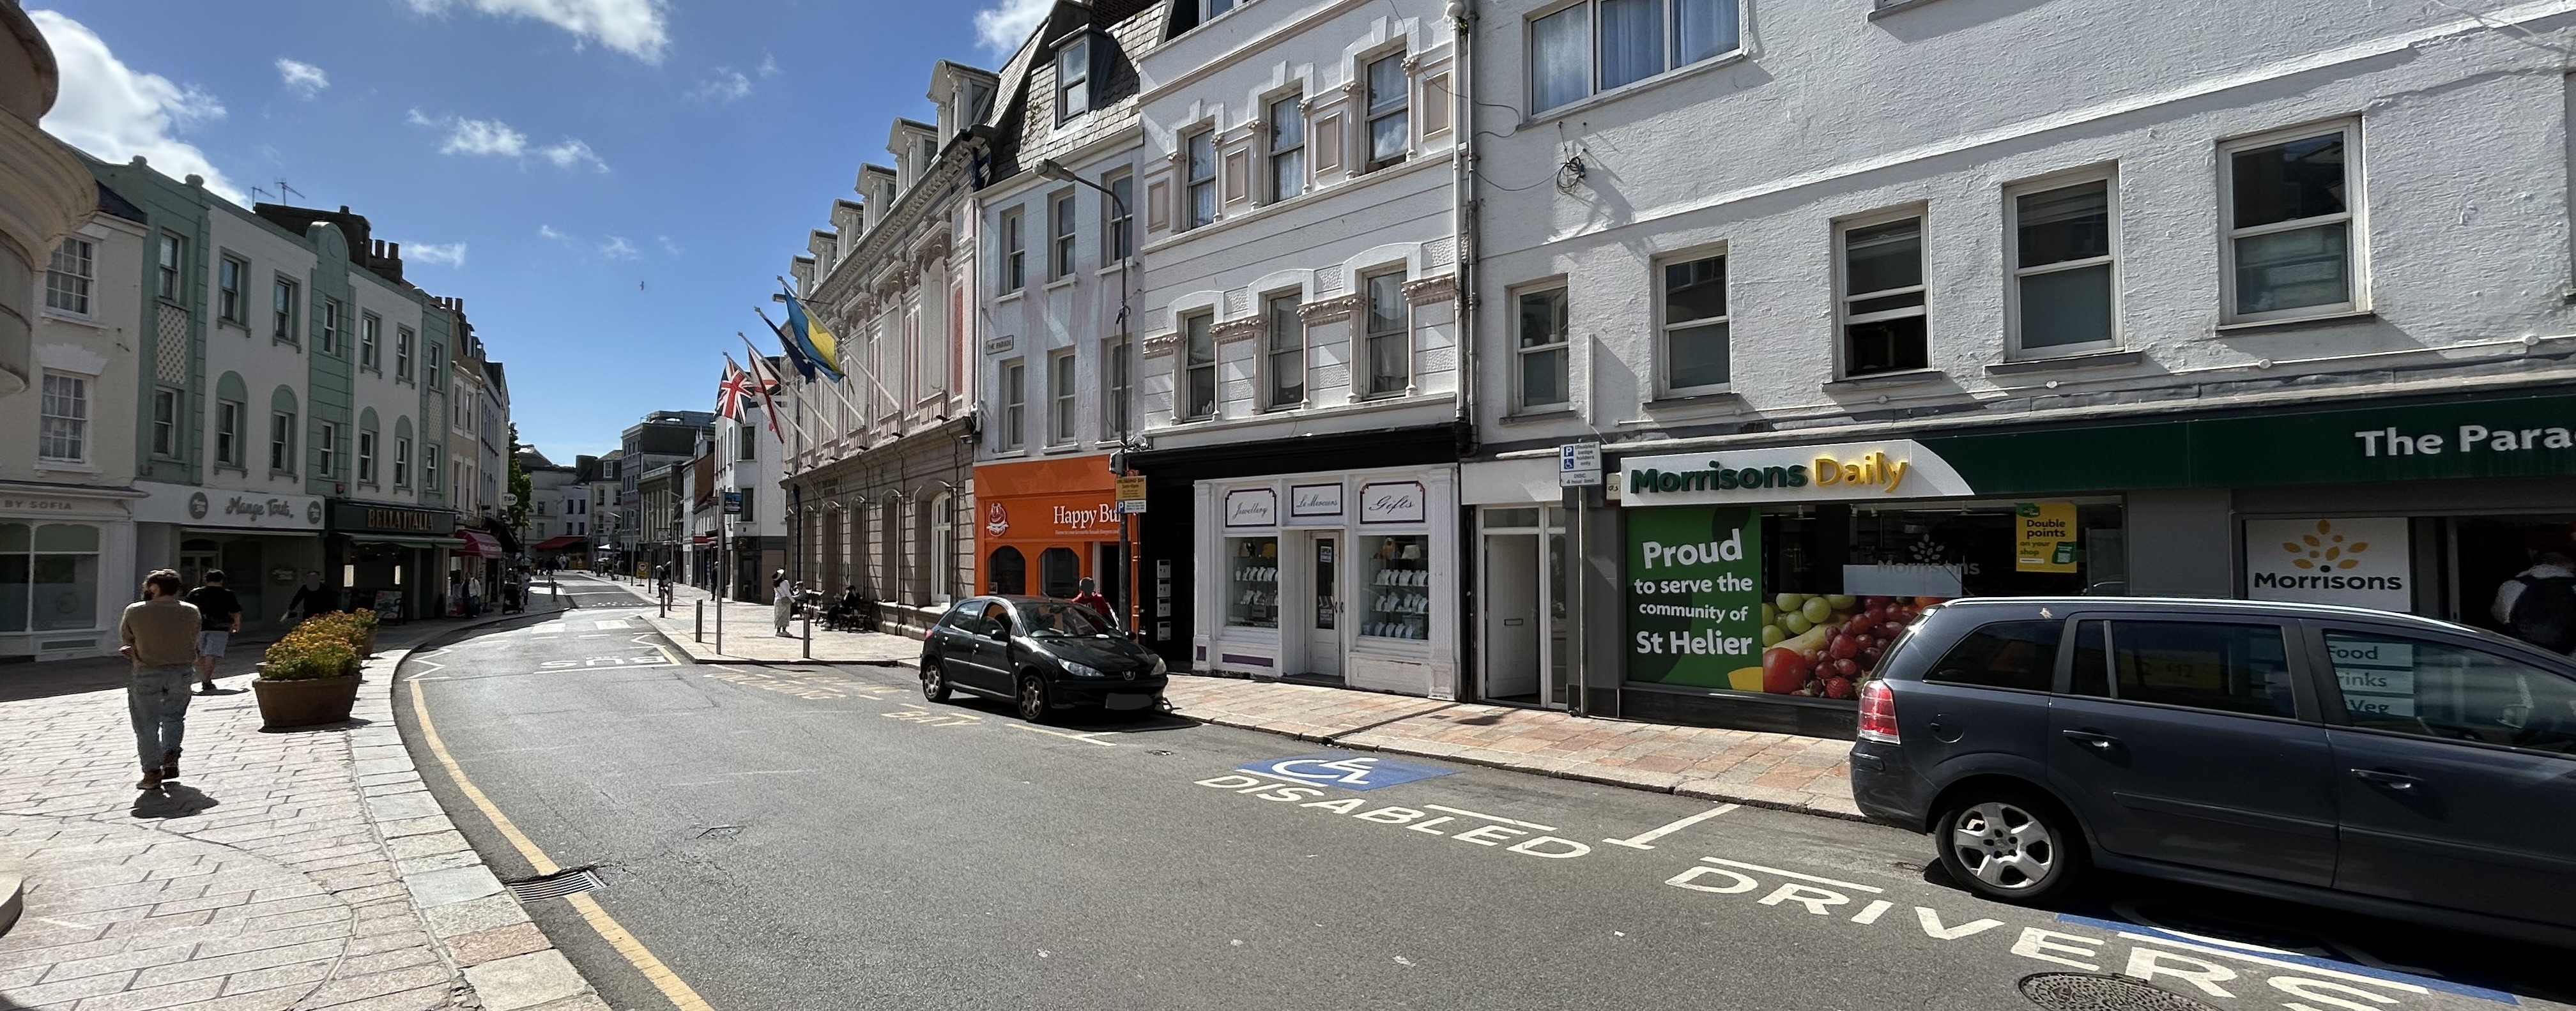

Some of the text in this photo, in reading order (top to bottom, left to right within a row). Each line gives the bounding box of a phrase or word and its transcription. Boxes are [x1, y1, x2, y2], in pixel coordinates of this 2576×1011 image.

[1566, 447, 1572, 457] P
[2355, 425, 2576, 457] The Para
[1630, 452, 1908, 494] Morrisons Daily
[29, 501, 72, 510] SOFIA
[225, 496, 265, 522] Mange
[1054, 503, 1121, 529] Happy Bu
[1118, 501, 1124, 512] P
[1368, 495, 1415, 515] Gifts
[367, 509, 434, 531] BELLA ITALIA
[2027, 519, 2066, 528] Double
[2027, 528, 2066, 539] points
[1643, 528, 1742, 568] Proud
[1878, 559, 1980, 575] Morrisons
[2254, 565, 2402, 590] Morrisons
[1634, 572, 1753, 594] to serve the
[1639, 604, 1749, 623] community of
[1636, 628, 1753, 655] St Helier
[1193, 774, 1591, 859] DISABLED
